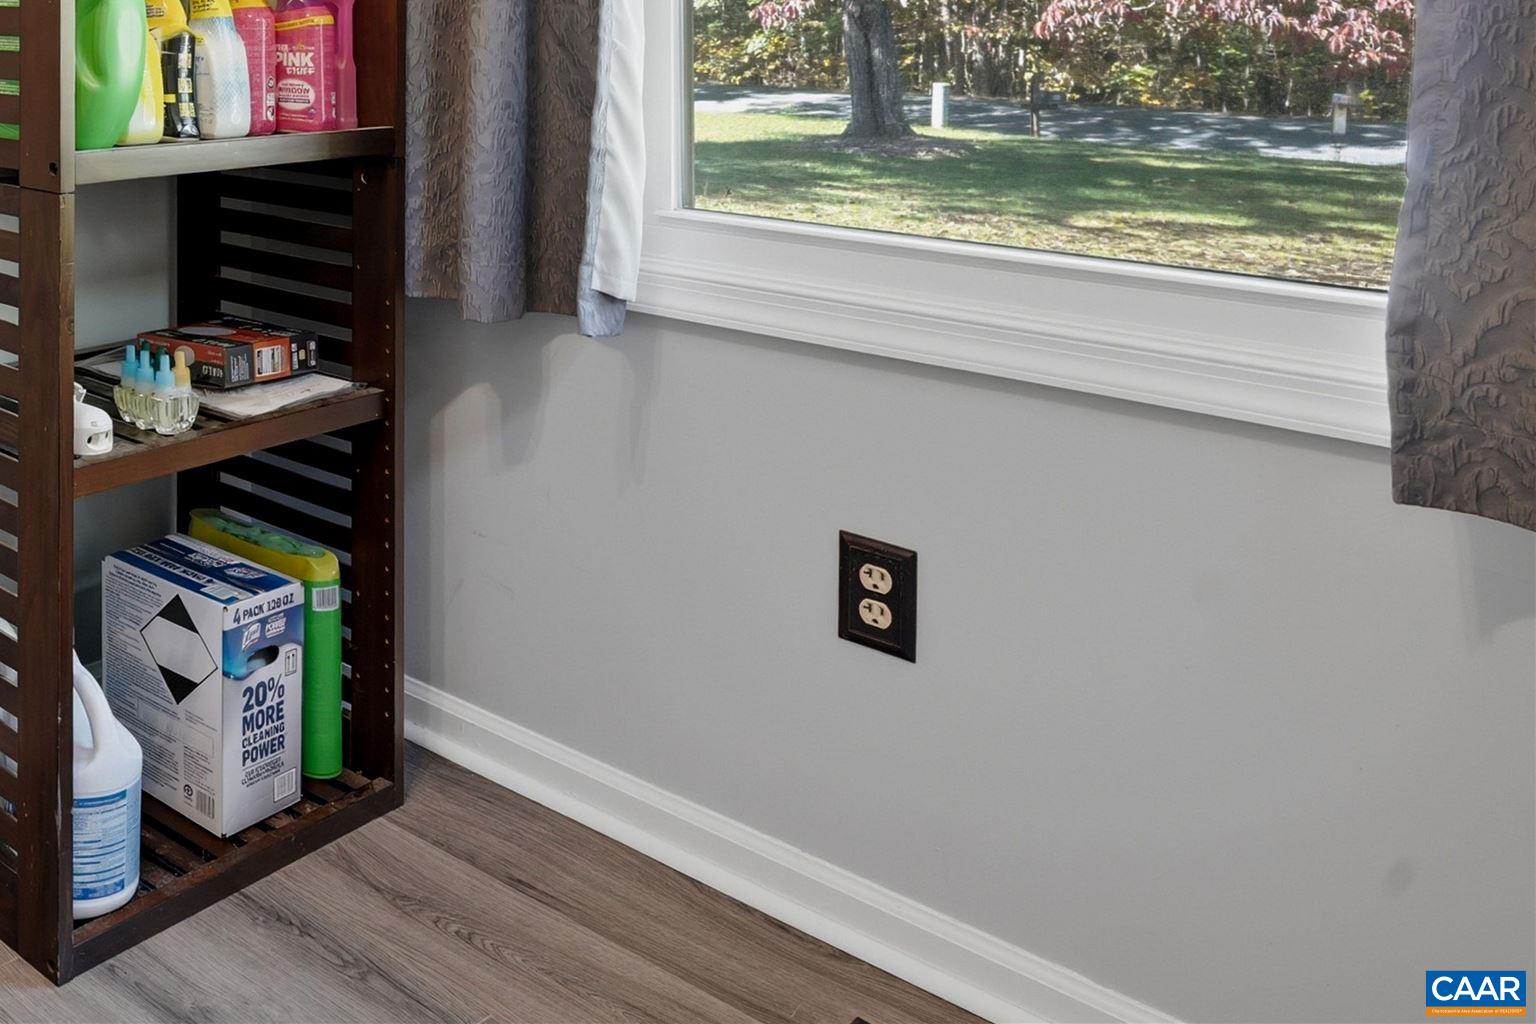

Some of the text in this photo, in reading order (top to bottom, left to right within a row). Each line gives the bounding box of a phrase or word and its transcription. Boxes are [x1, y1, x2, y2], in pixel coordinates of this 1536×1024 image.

[276, 51, 315, 67] PINK
[233, 607, 241, 625] 4
[242, 602, 265, 621] PACK
[242, 673, 285, 714] 20%
[242, 699, 285, 736] MORE
[241, 722, 285, 749] CLEANING
[242, 734, 286, 767] POWER
